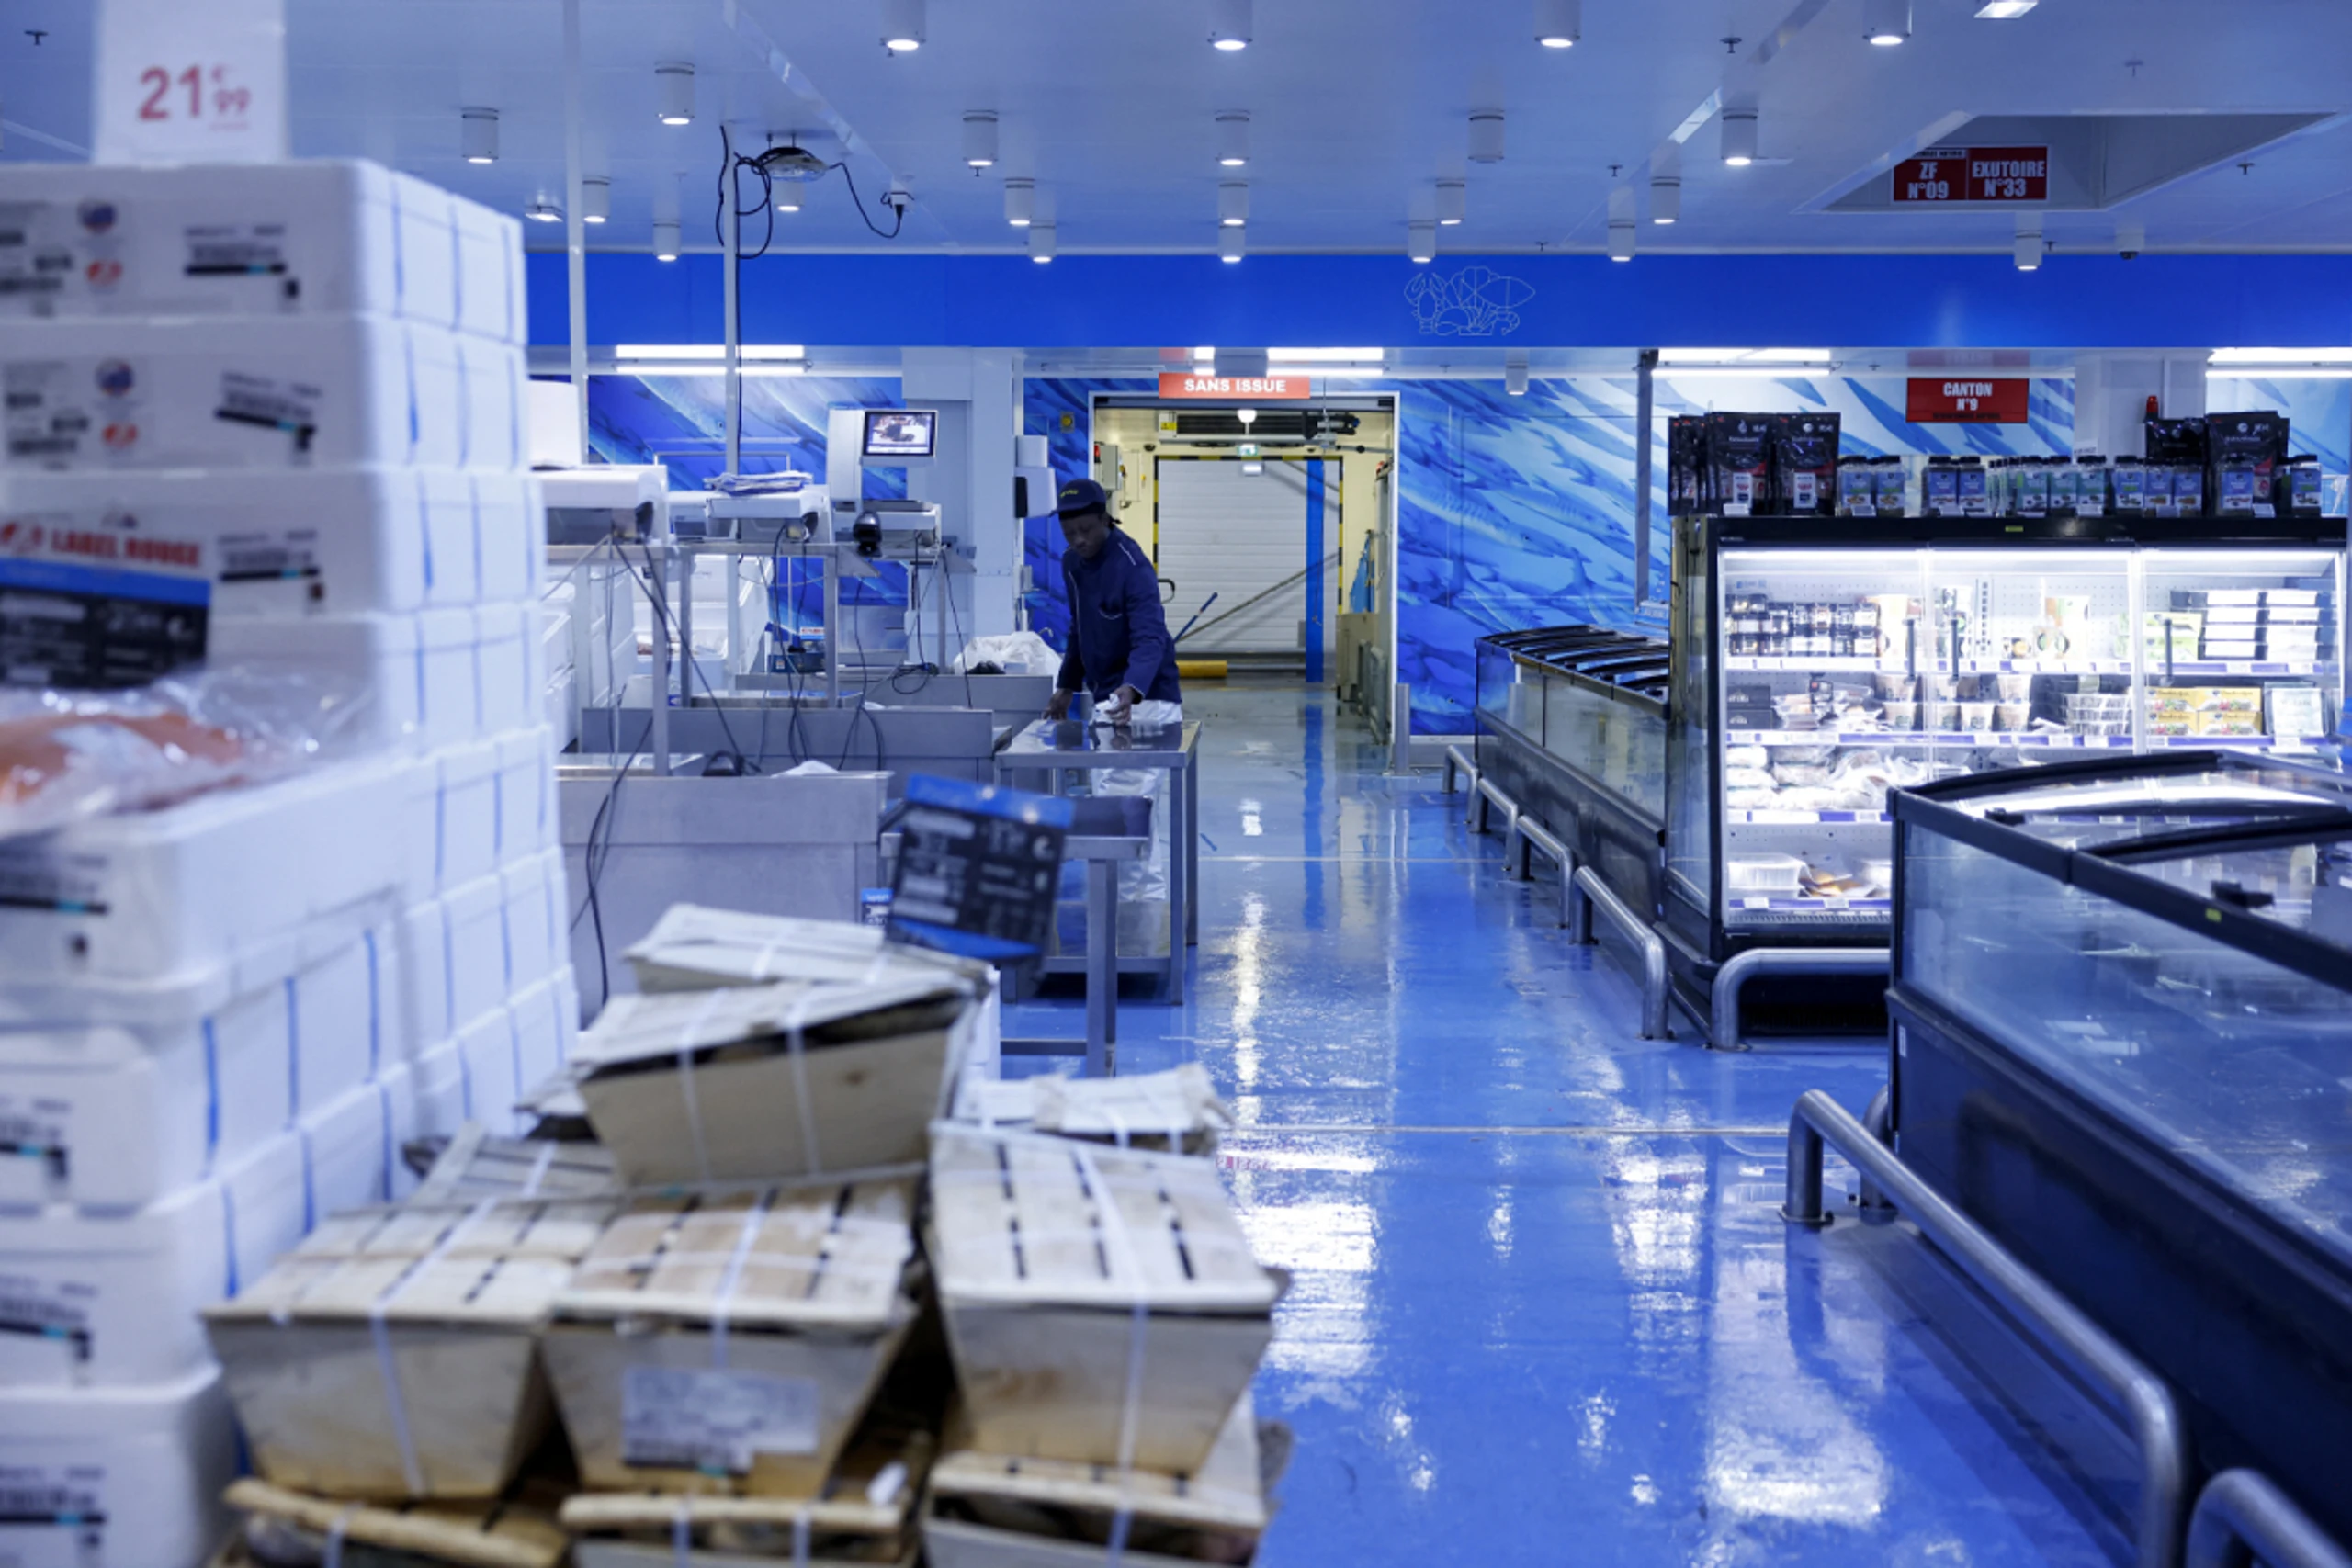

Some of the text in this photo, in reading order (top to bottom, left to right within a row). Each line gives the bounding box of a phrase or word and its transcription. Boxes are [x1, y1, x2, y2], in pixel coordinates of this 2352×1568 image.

[139, 64, 201, 121] 21
[1919, 161, 1939, 179] ZF
[1972, 160, 2045, 178] EXUTOIRE
[1906, 180, 1950, 199] N°09
[1984, 178, 2027, 197] N°33
[1183, 378, 1287, 393] SANS ISSUE
[1942, 381, 1993, 397] CANTON
[1956, 398, 1979, 411] N°9
[51, 528, 118, 558] LABEL
